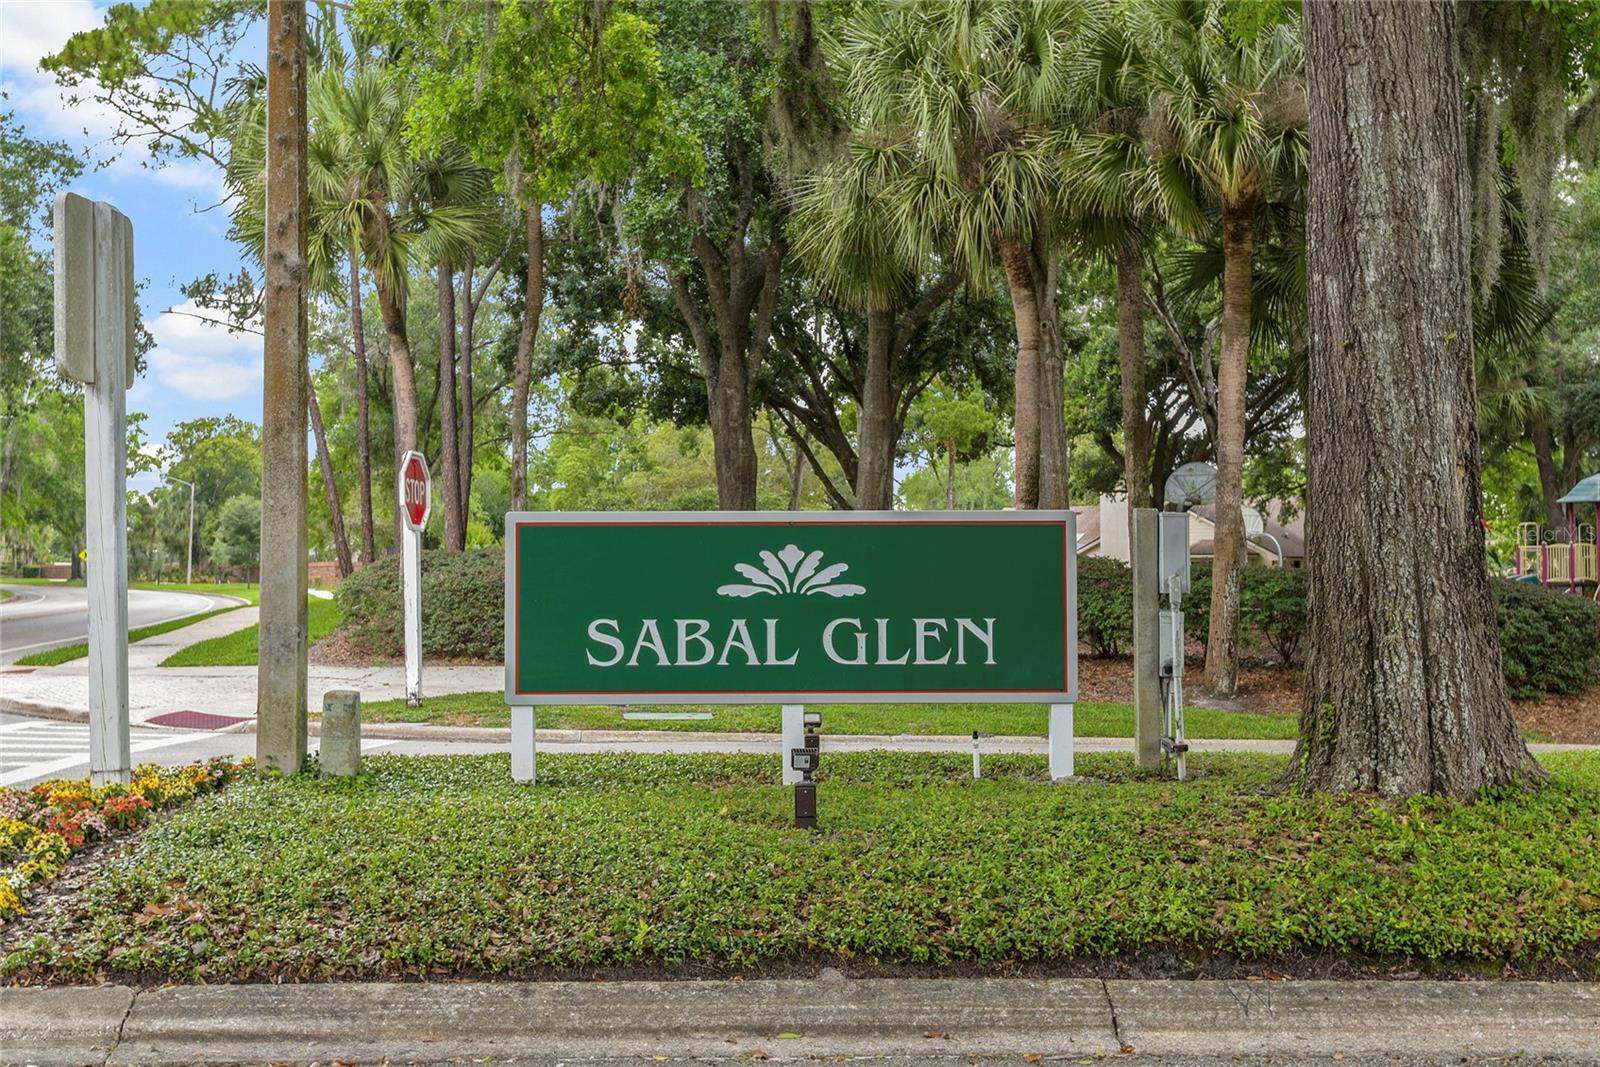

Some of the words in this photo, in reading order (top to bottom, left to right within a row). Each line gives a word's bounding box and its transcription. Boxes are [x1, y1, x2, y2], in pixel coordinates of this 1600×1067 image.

[405, 478, 425, 505] STOP
[585, 618, 800, 667] SABAL
[822, 617, 998, 665] GLEN
